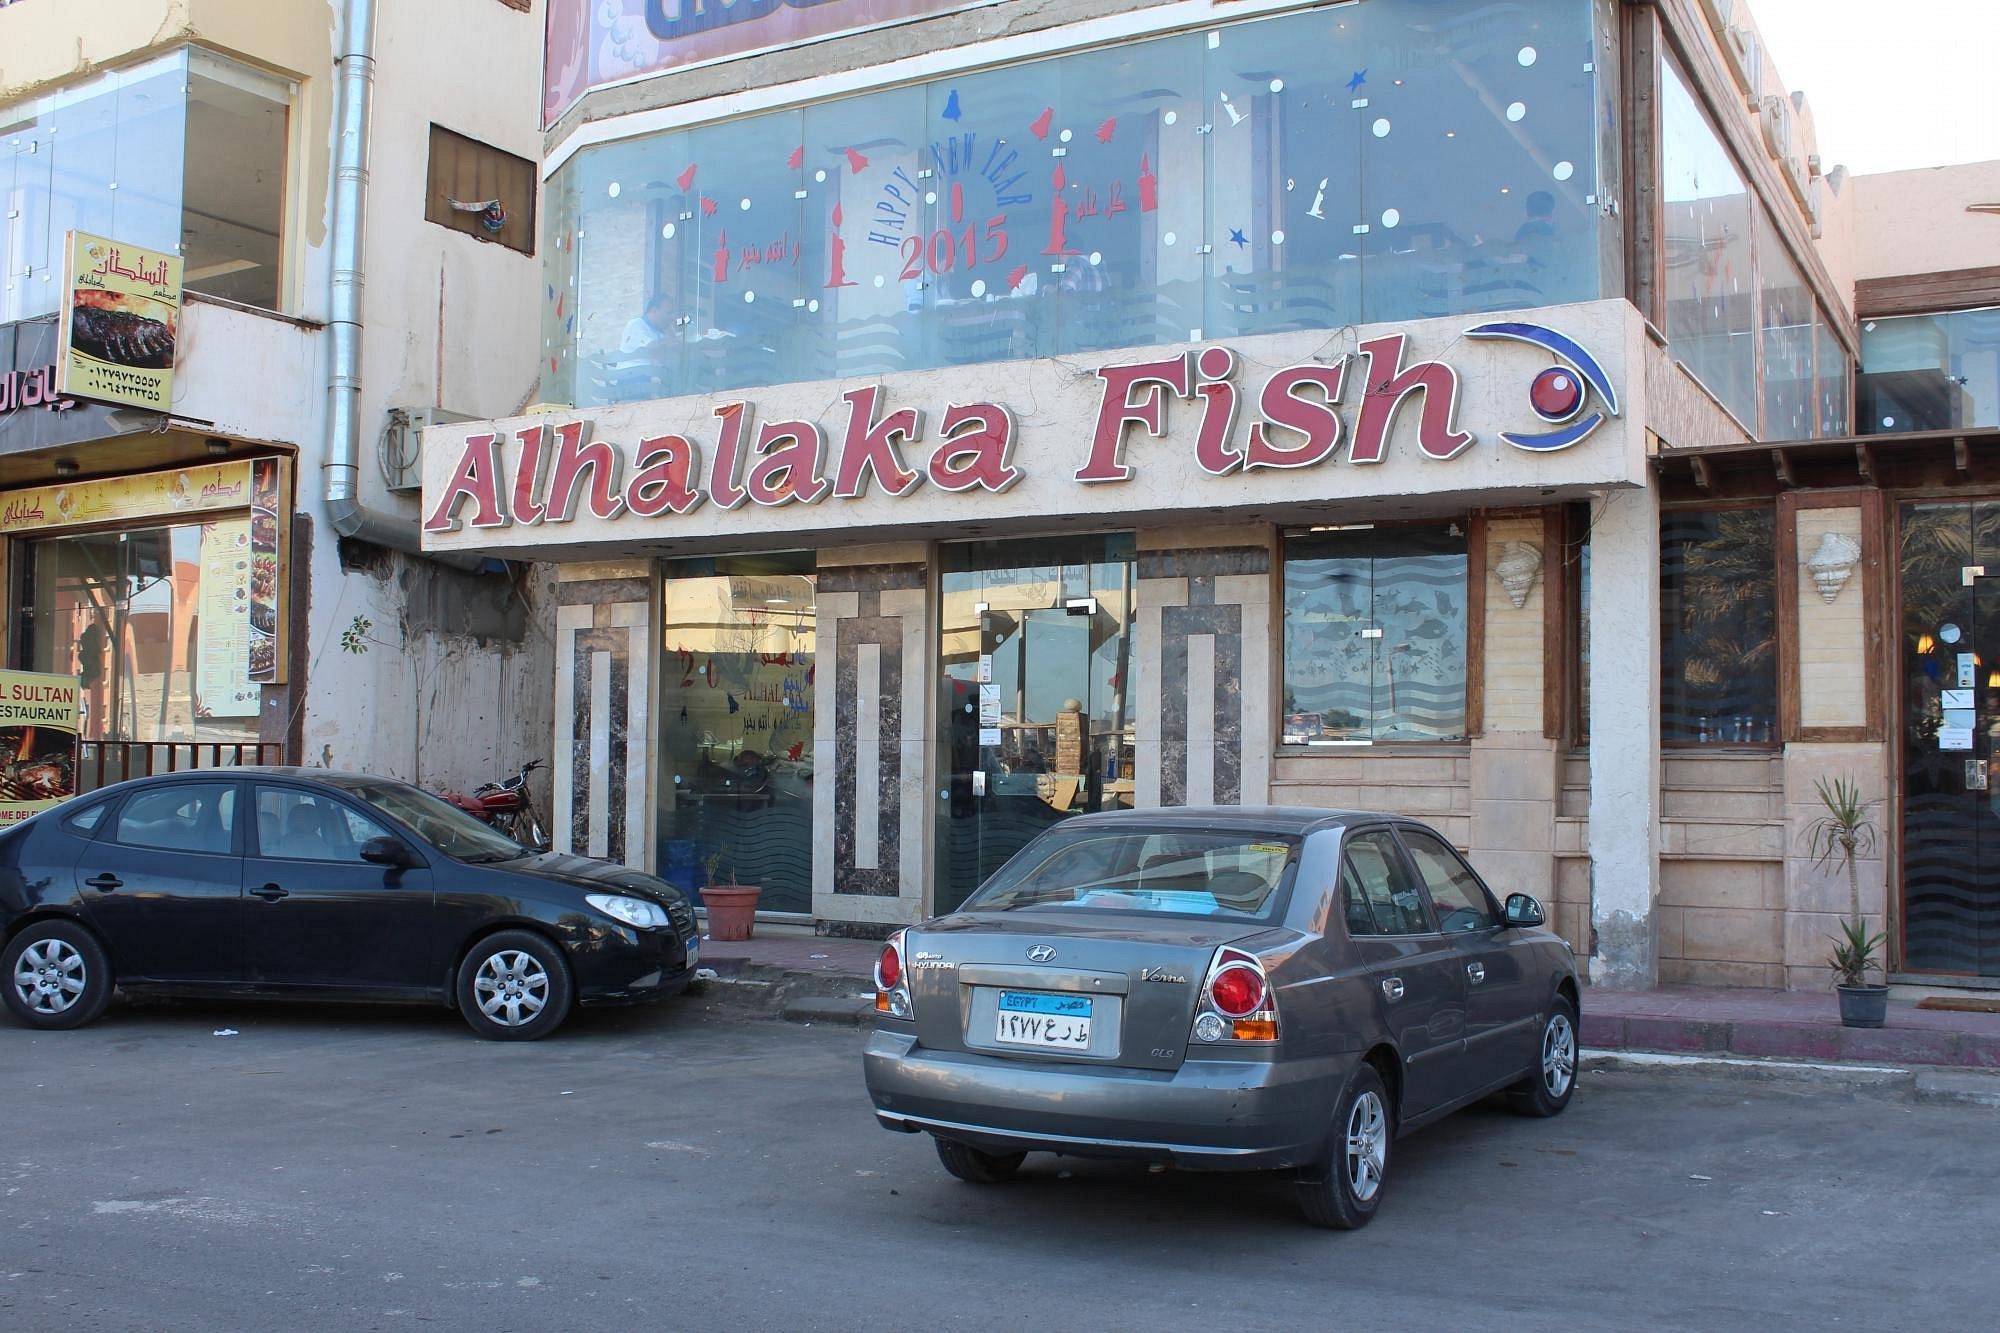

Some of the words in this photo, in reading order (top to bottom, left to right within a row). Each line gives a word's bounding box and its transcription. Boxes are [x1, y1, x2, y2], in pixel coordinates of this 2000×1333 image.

[868, 165, 919, 247] HAPPY
[930, 132, 976, 180] NEW
[981, 138, 1033, 207] YEAR
[898, 212, 1009, 282] 2015
[424, 384, 1022, 533] Alhalaka
[1074, 332, 1474, 483] Fish
[12, 684, 73, 703] SULTAN
[1006, 995, 1039, 1009] EGYPT
[1055, 1000, 1084, 1011] مصر
